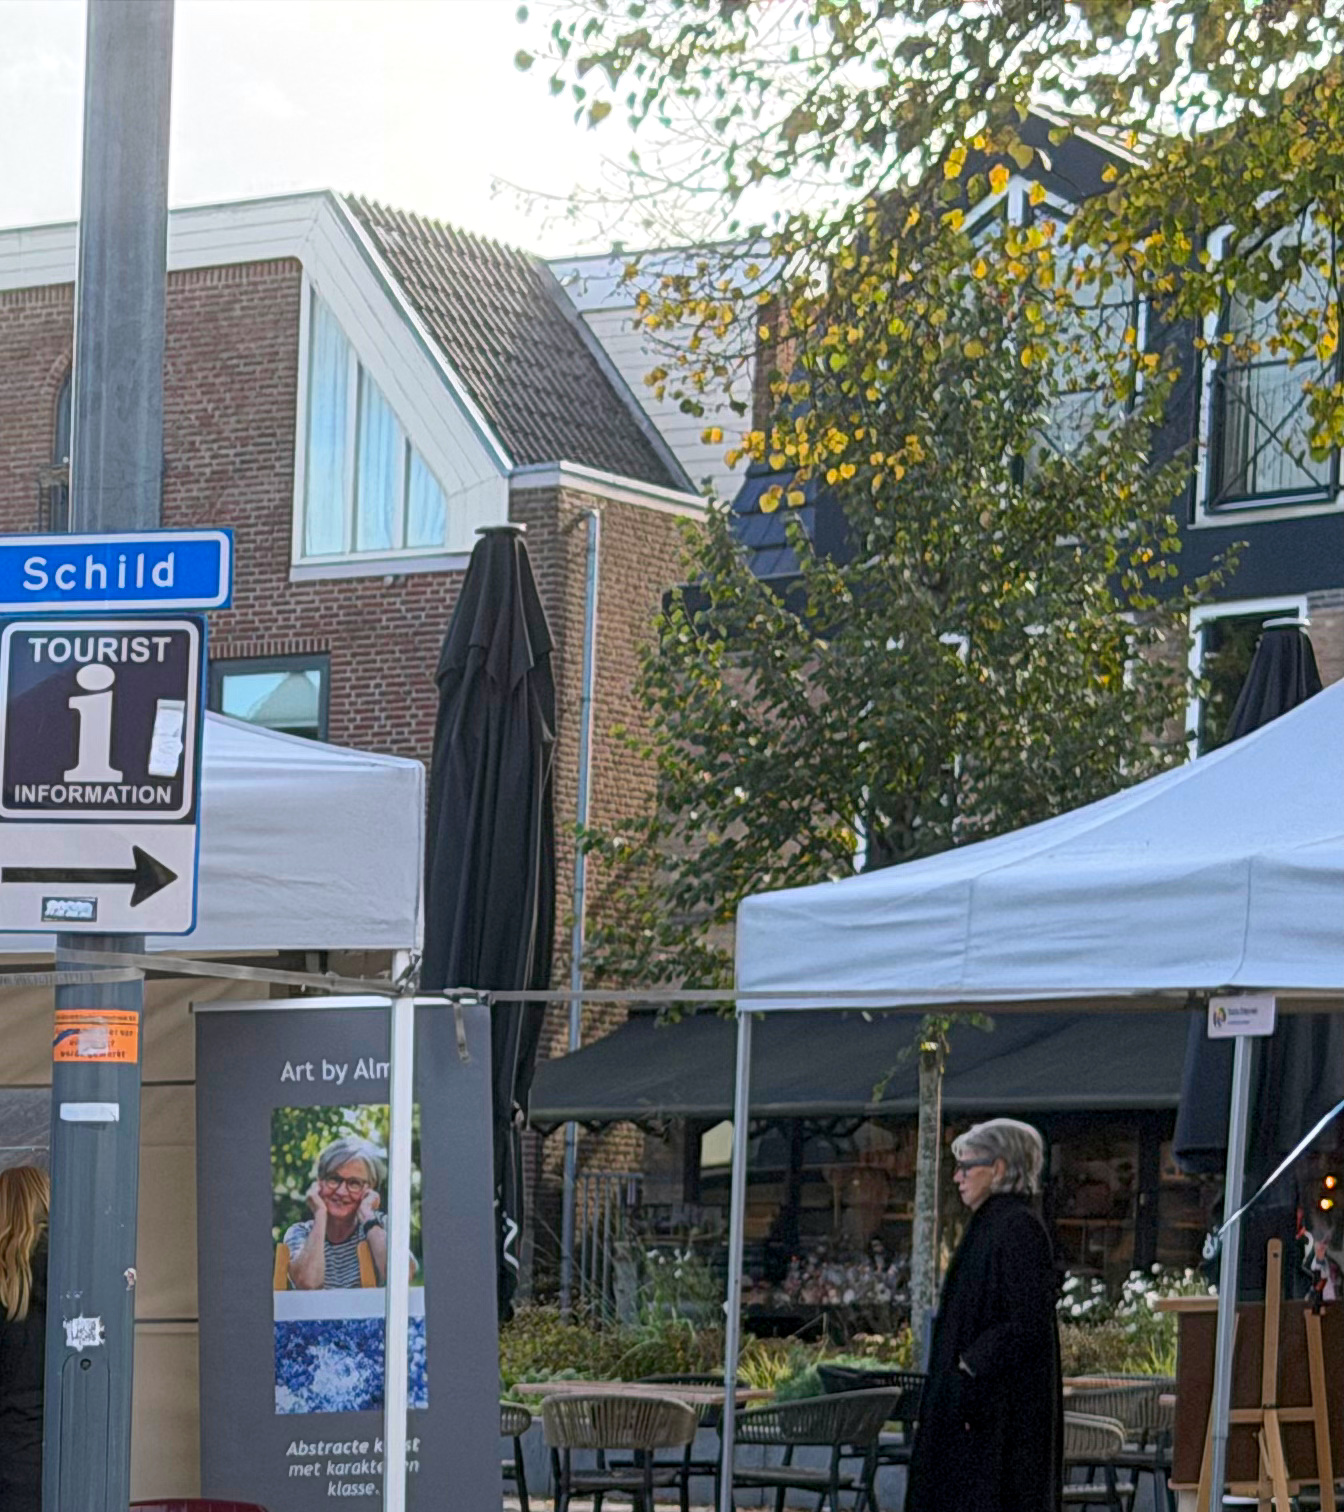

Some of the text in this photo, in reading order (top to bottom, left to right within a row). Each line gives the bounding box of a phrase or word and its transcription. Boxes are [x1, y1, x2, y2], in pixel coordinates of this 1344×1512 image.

[22, 552, 175, 591] Schild
[28, 636, 172, 663] TOURIST
[14, 783, 172, 805] INFORMATION
[280, 1057, 390, 1086] Art by Alm
[285, 1436, 421, 1457] Abstracte kst
[288, 1462, 322, 1478] met
[326, 1459, 384, 1476] karakte
[327, 1480, 382, 1497] klasse.
